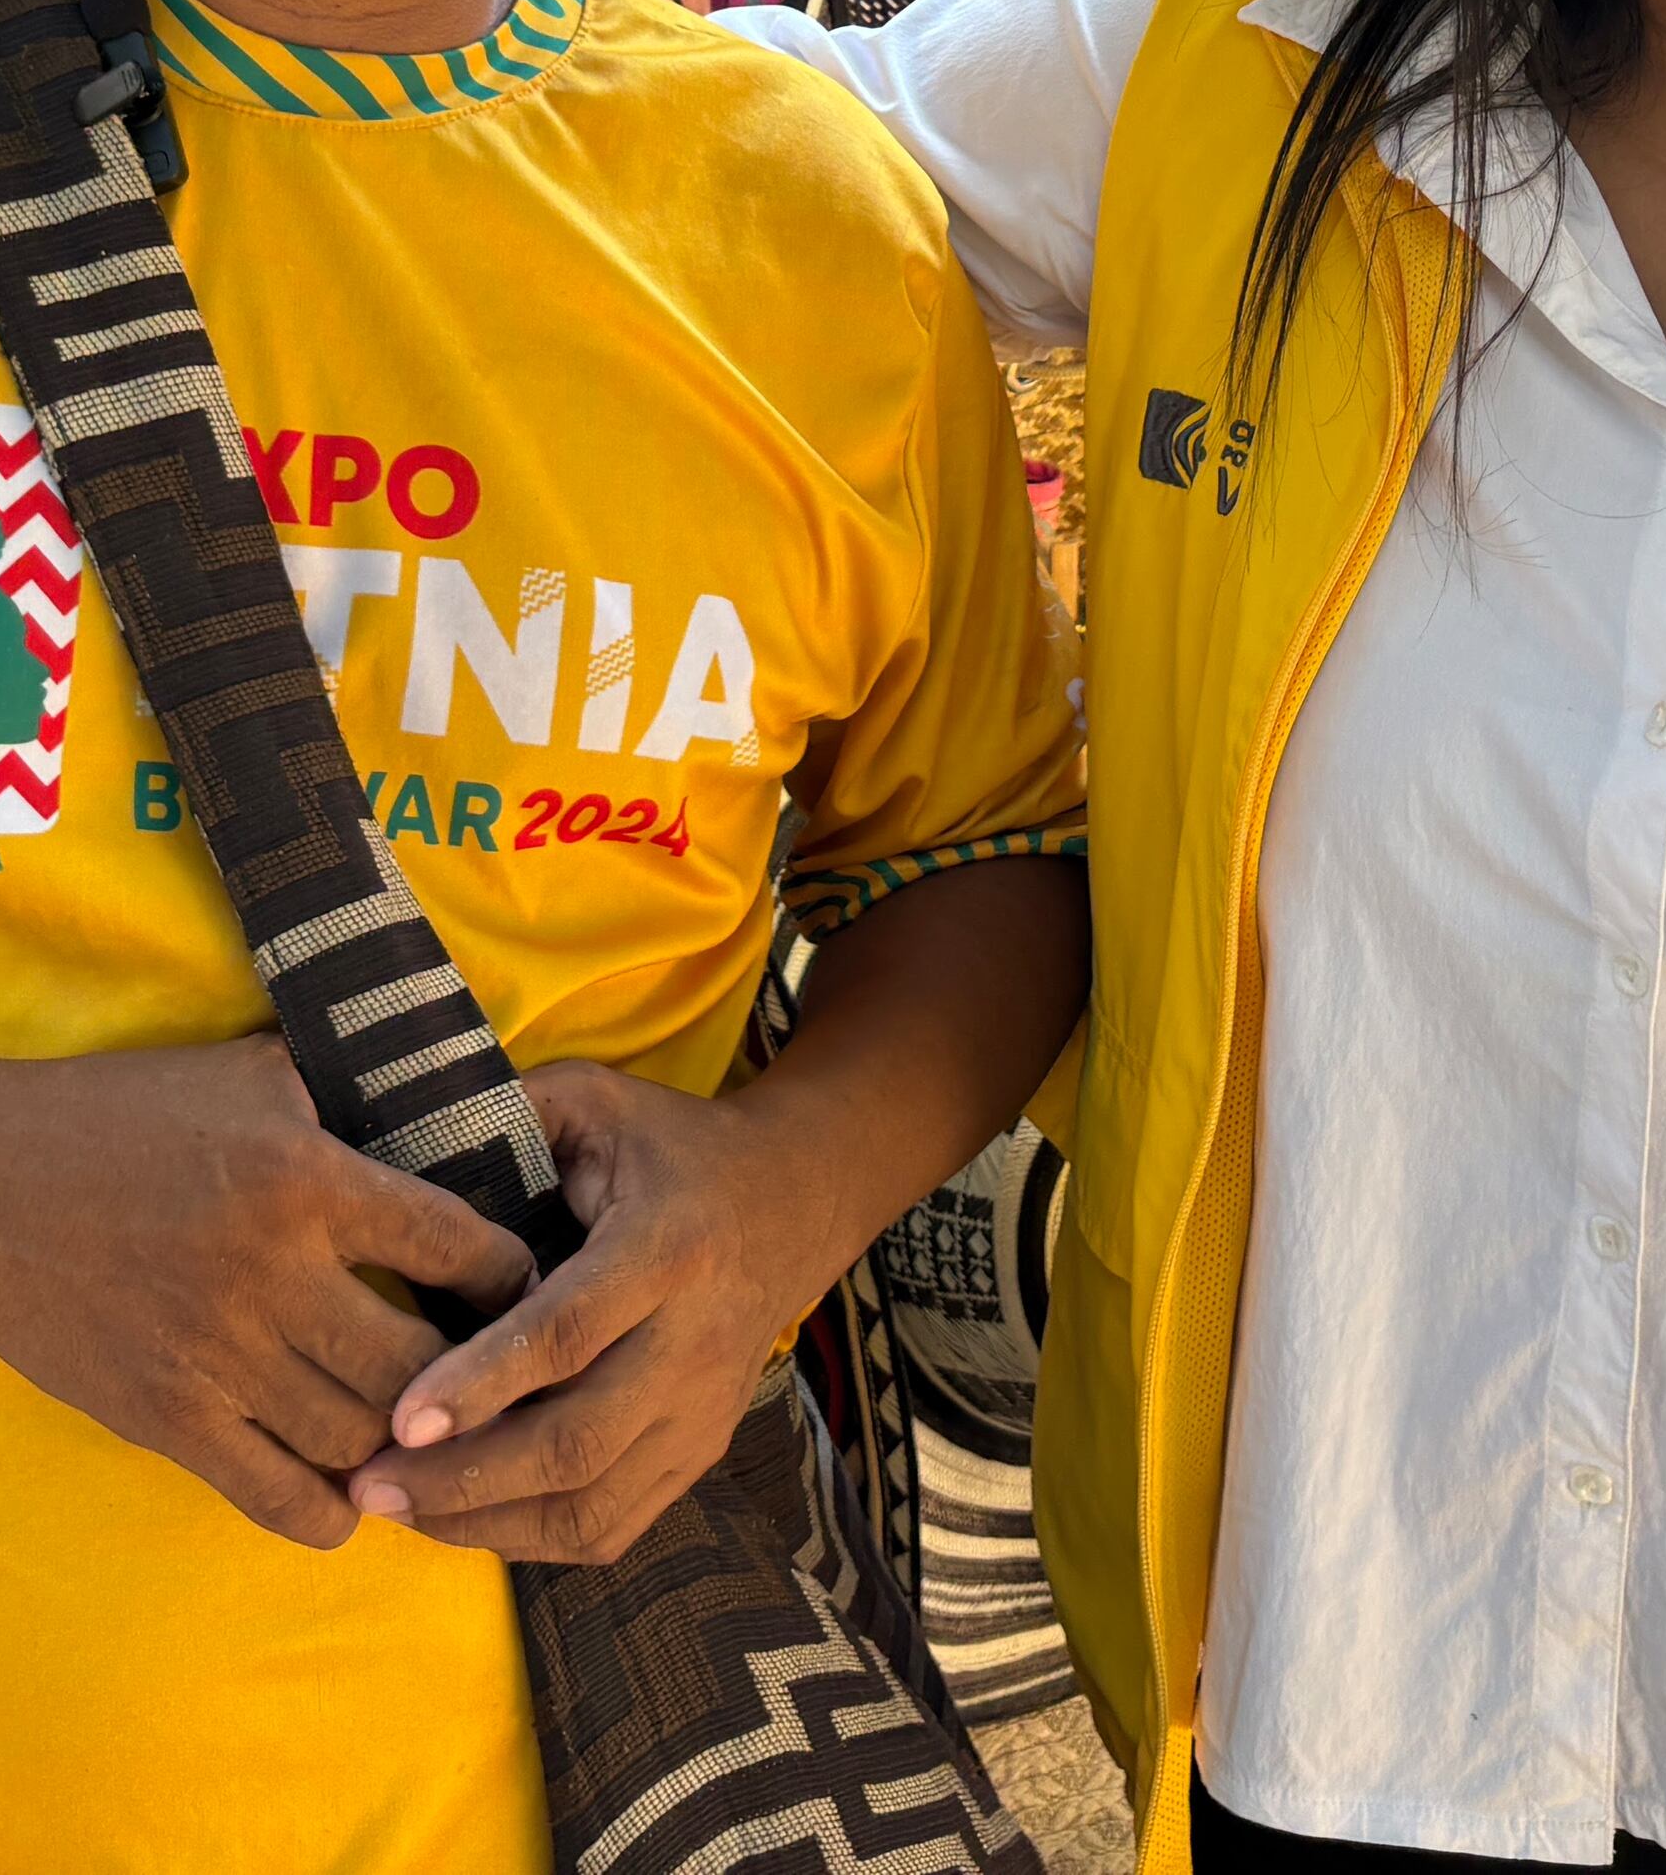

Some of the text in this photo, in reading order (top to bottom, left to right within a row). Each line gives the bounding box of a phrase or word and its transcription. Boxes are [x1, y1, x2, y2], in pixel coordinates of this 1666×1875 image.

[241, 426, 480, 540] XPO
[279, 544, 760, 768] TNIA
[514, 788, 690, 858] 2024
